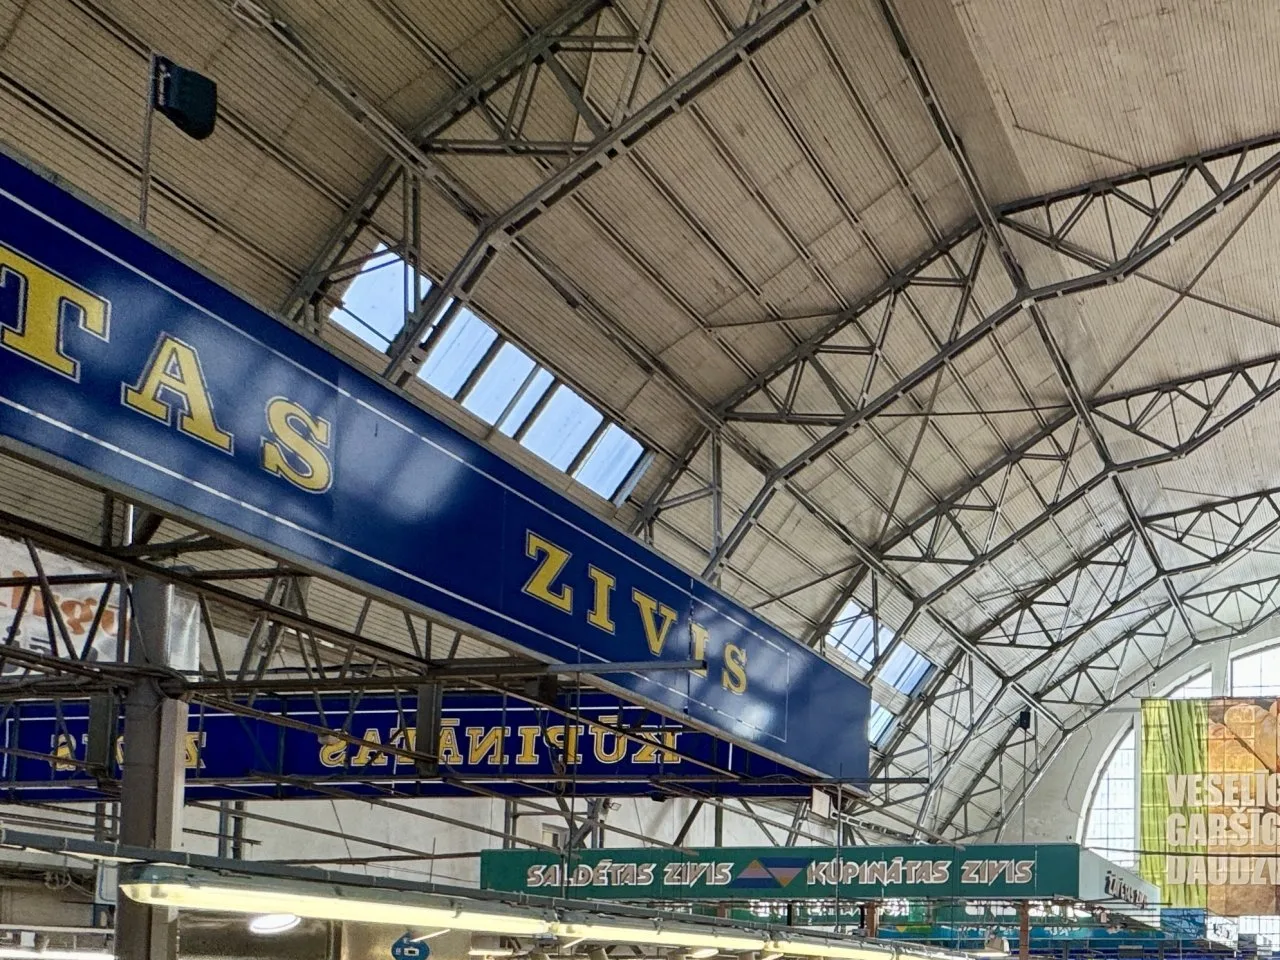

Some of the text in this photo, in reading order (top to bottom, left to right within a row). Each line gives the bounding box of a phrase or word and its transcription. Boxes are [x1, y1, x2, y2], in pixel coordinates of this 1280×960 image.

[521, 529, 748, 696] ZIVIS
[526, 856, 1036, 888] SALDĒTAS ZIVIS KŪPINĀTAS ZIVIS
